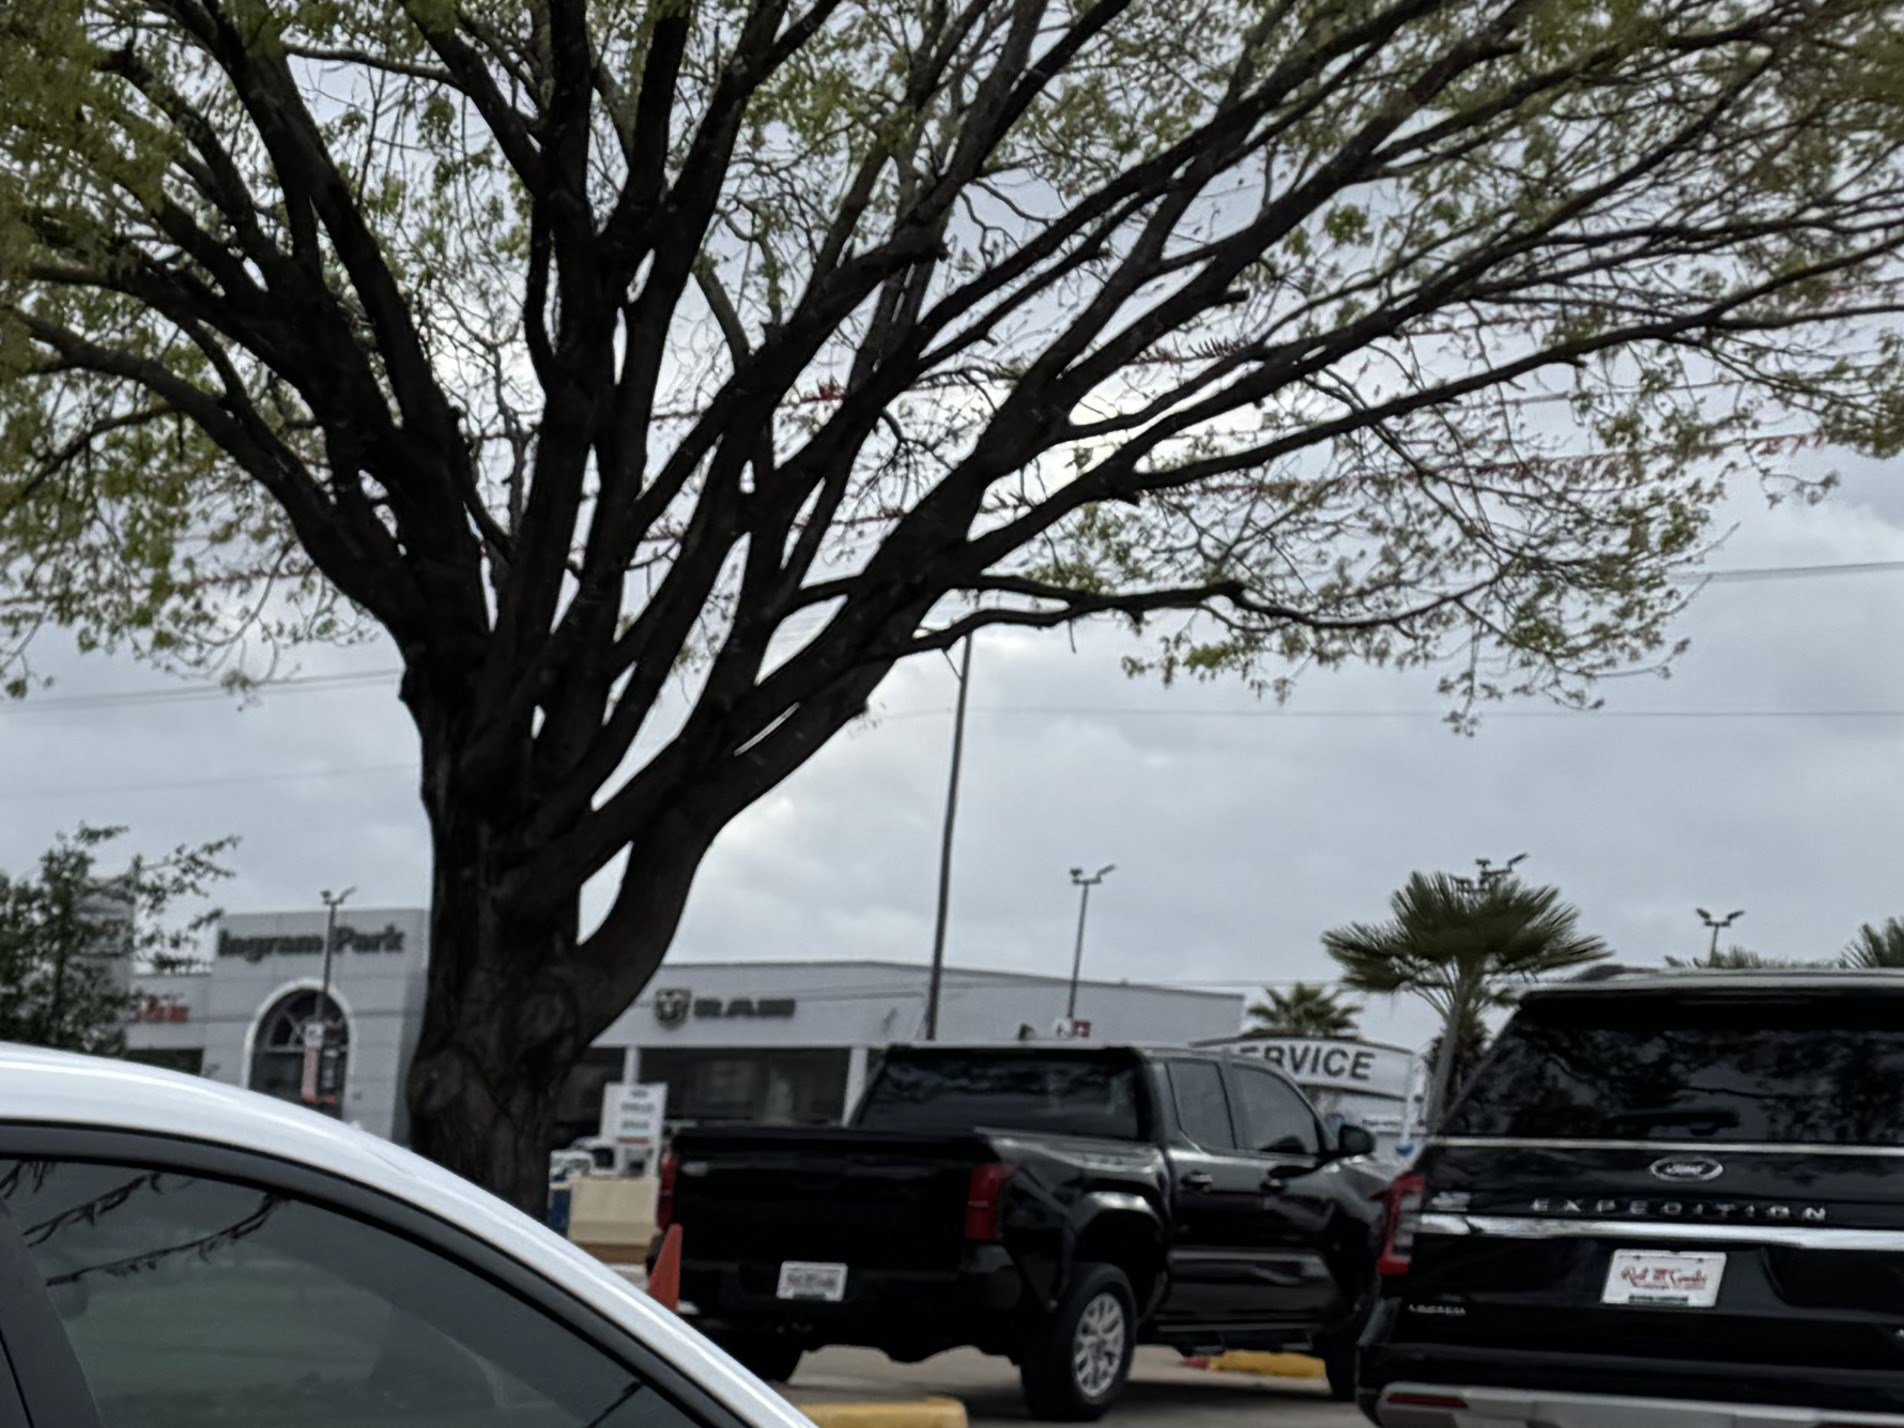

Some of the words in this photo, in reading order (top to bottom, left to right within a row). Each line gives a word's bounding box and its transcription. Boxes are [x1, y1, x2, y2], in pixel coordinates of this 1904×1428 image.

[218, 929, 324, 964] Ingram
[329, 922, 405, 954] Park
[1240, 1044, 1375, 1081] RVICE
[1531, 1198, 1826, 1221] EXPEDITION
